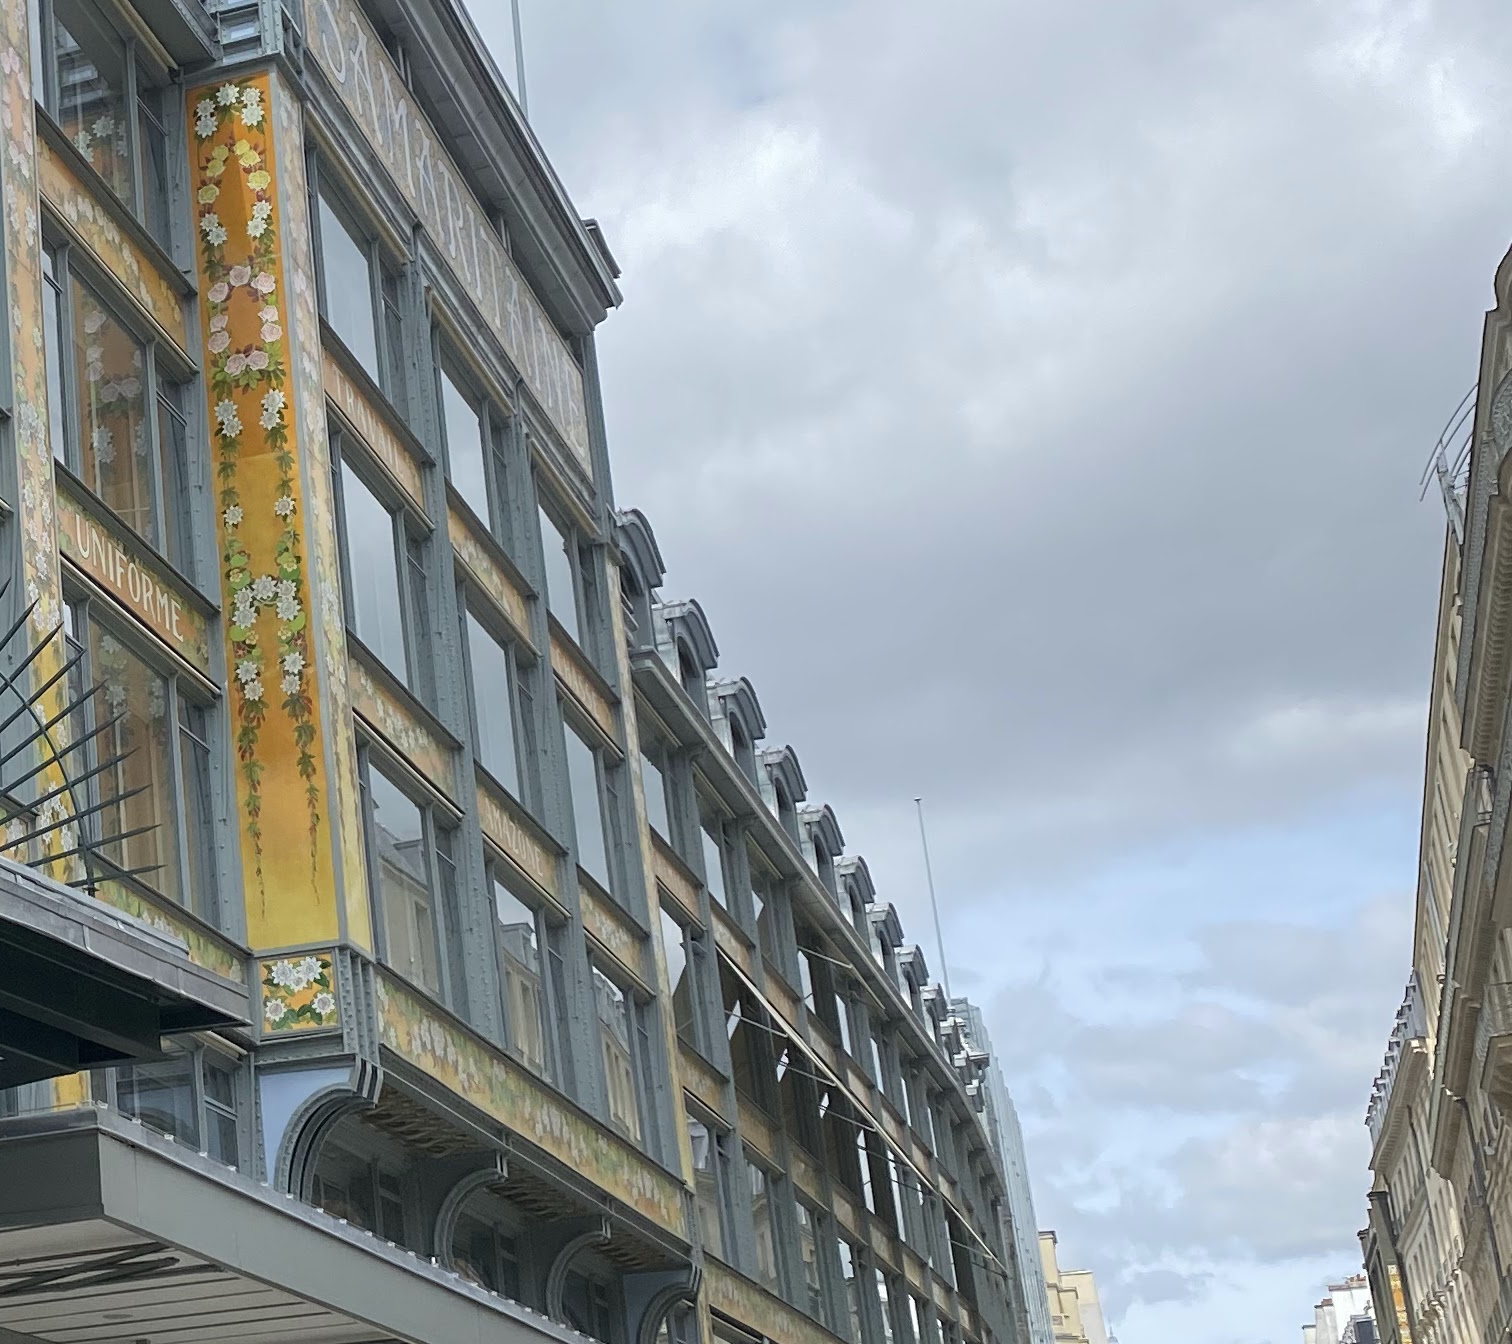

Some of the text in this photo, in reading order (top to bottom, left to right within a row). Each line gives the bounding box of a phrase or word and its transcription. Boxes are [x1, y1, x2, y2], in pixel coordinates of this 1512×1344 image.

[332, 362, 404, 479] TRAVAIL
[75, 514, 184, 643] UNIFORME
[485, 797, 544, 878] AMAZONE
